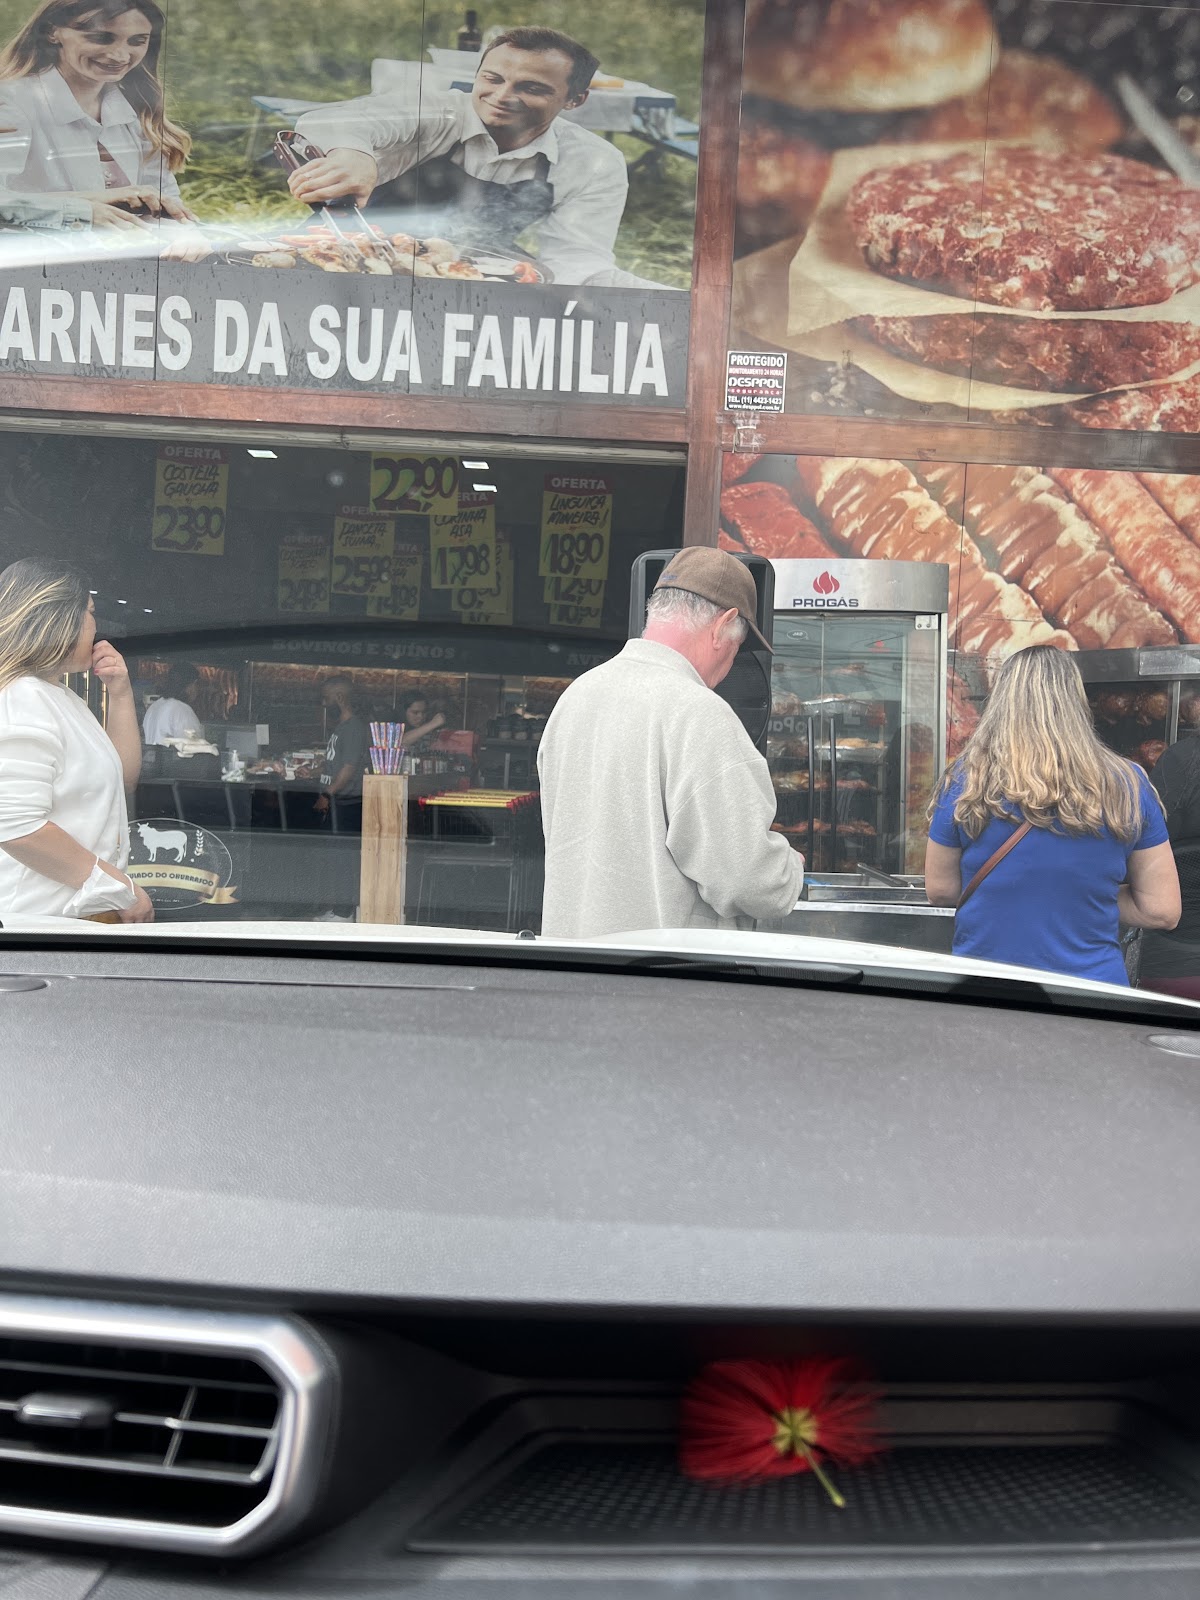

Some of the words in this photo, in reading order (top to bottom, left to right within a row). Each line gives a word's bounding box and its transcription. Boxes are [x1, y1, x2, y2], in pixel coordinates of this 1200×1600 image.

[0, 286, 193, 371] ARNES
[212, 299, 288, 377] DA
[306, 303, 422, 385] SUA
[440, 300, 669, 397] FAMÍLIA
[730, 354, 783, 367] PROTEGIDO
[728, 377, 782, 388] DESPPOL
[741, 396, 752, 404] (11)
[165, 445, 222, 460] OFERTA
[551, 477, 607, 490] OFERTA
[450, 525, 473, 537] ASA
[792, 596, 860, 608] PROGÁS
[272, 638, 362, 655] BOVINOS
[366, 643, 379, 655] E
[155, 871, 167, 879] DO
